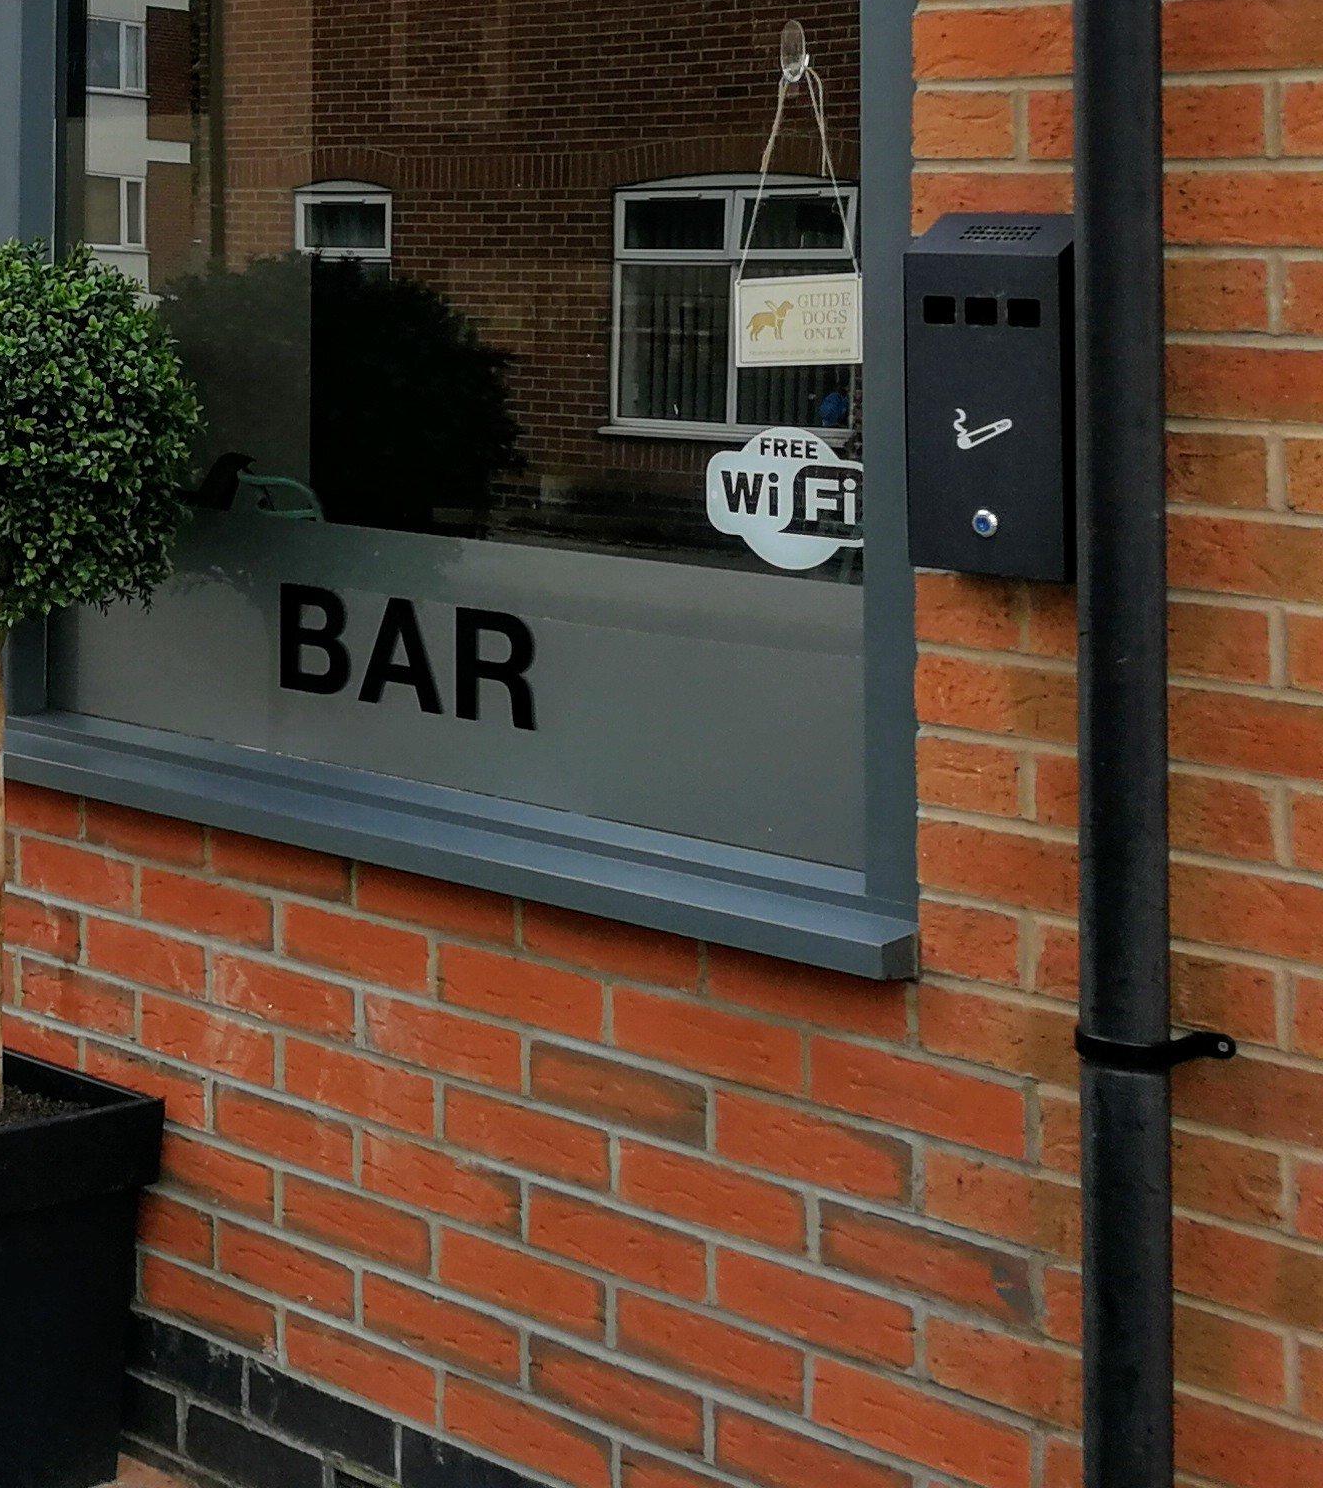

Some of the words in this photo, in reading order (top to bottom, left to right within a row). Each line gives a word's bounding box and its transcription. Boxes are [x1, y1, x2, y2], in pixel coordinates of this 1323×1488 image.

[797, 292, 852, 309] GUIDE
[803, 310, 848, 325] DOGS
[804, 327, 845, 340] ONLY
[760, 437, 818, 460] FREE
[279, 582, 537, 731] BAR
